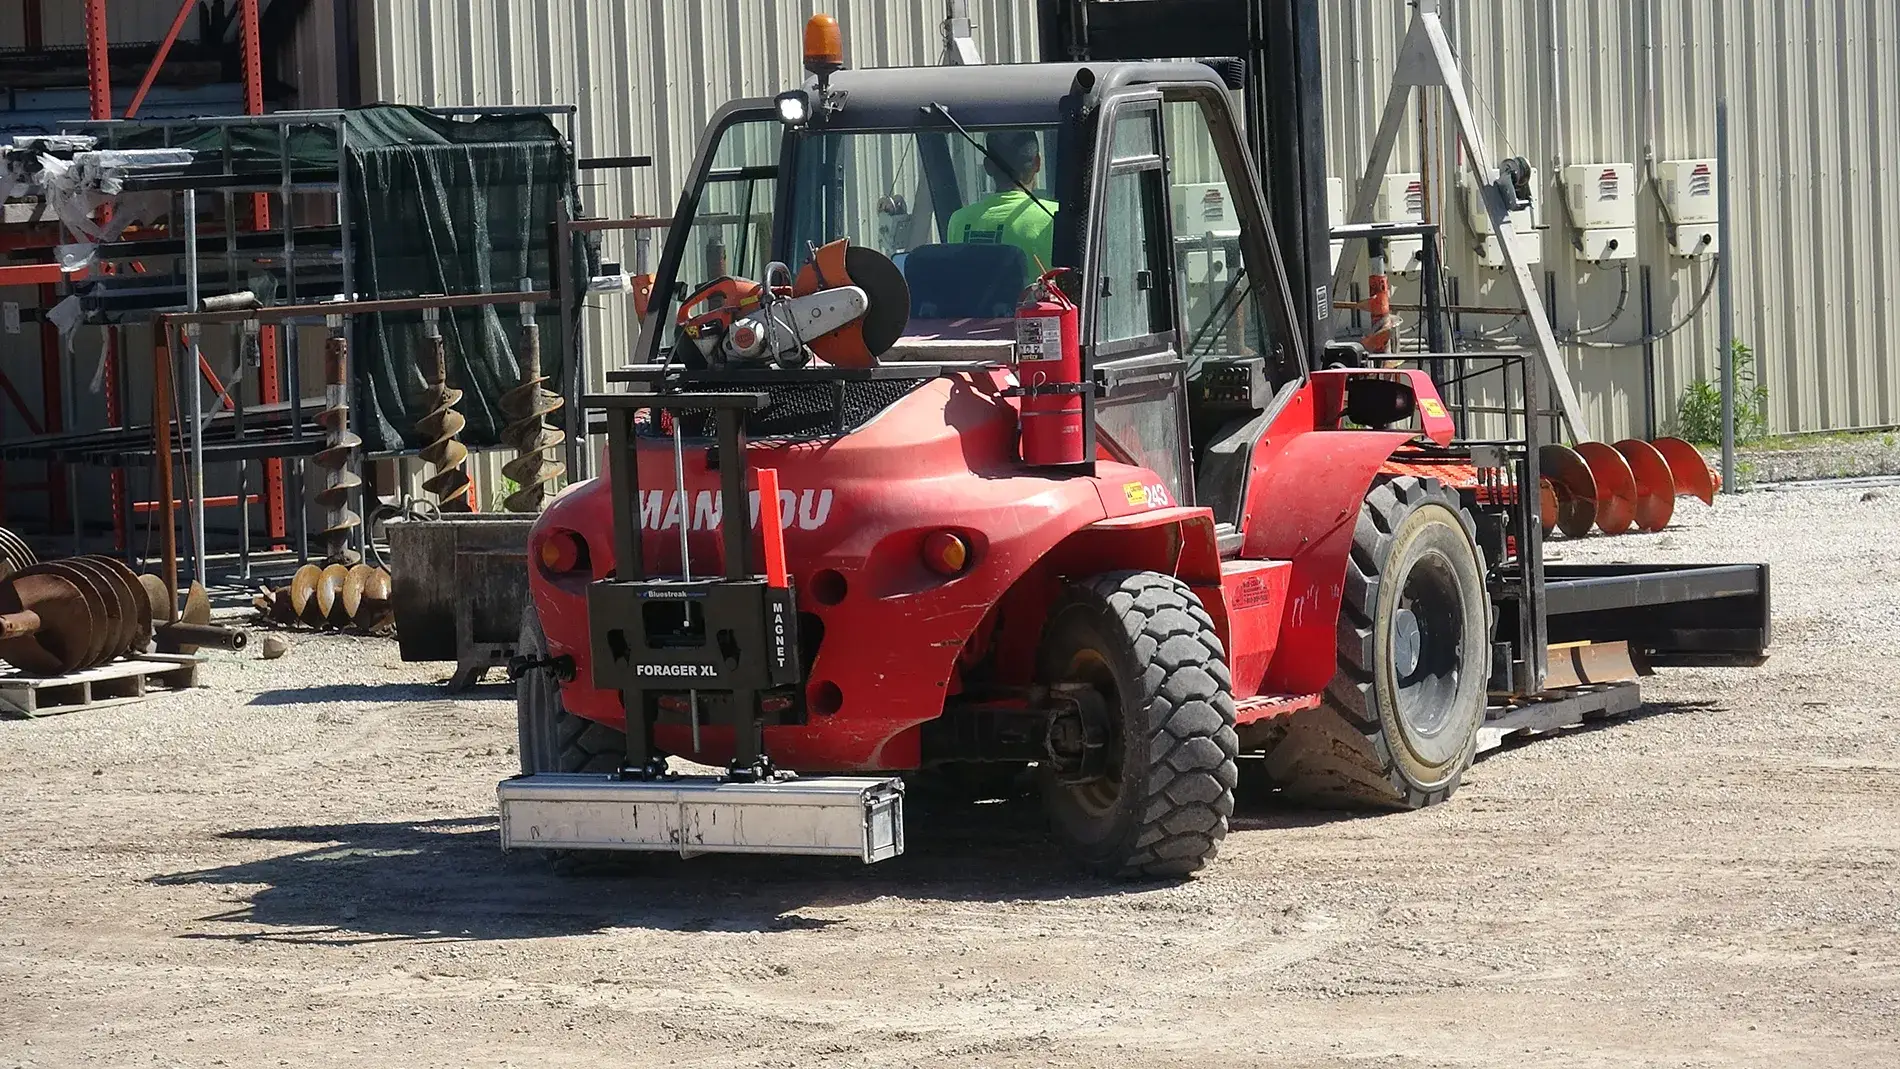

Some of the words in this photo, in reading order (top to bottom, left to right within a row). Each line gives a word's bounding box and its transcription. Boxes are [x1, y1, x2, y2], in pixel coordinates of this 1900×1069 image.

[1143, 483, 1169, 508] 243
[648, 590, 688, 598] Bluestreak
[772, 602, 785, 667] MAGNET
[636, 664, 698, 676] FORAGER
[700, 664, 718, 676] XL
